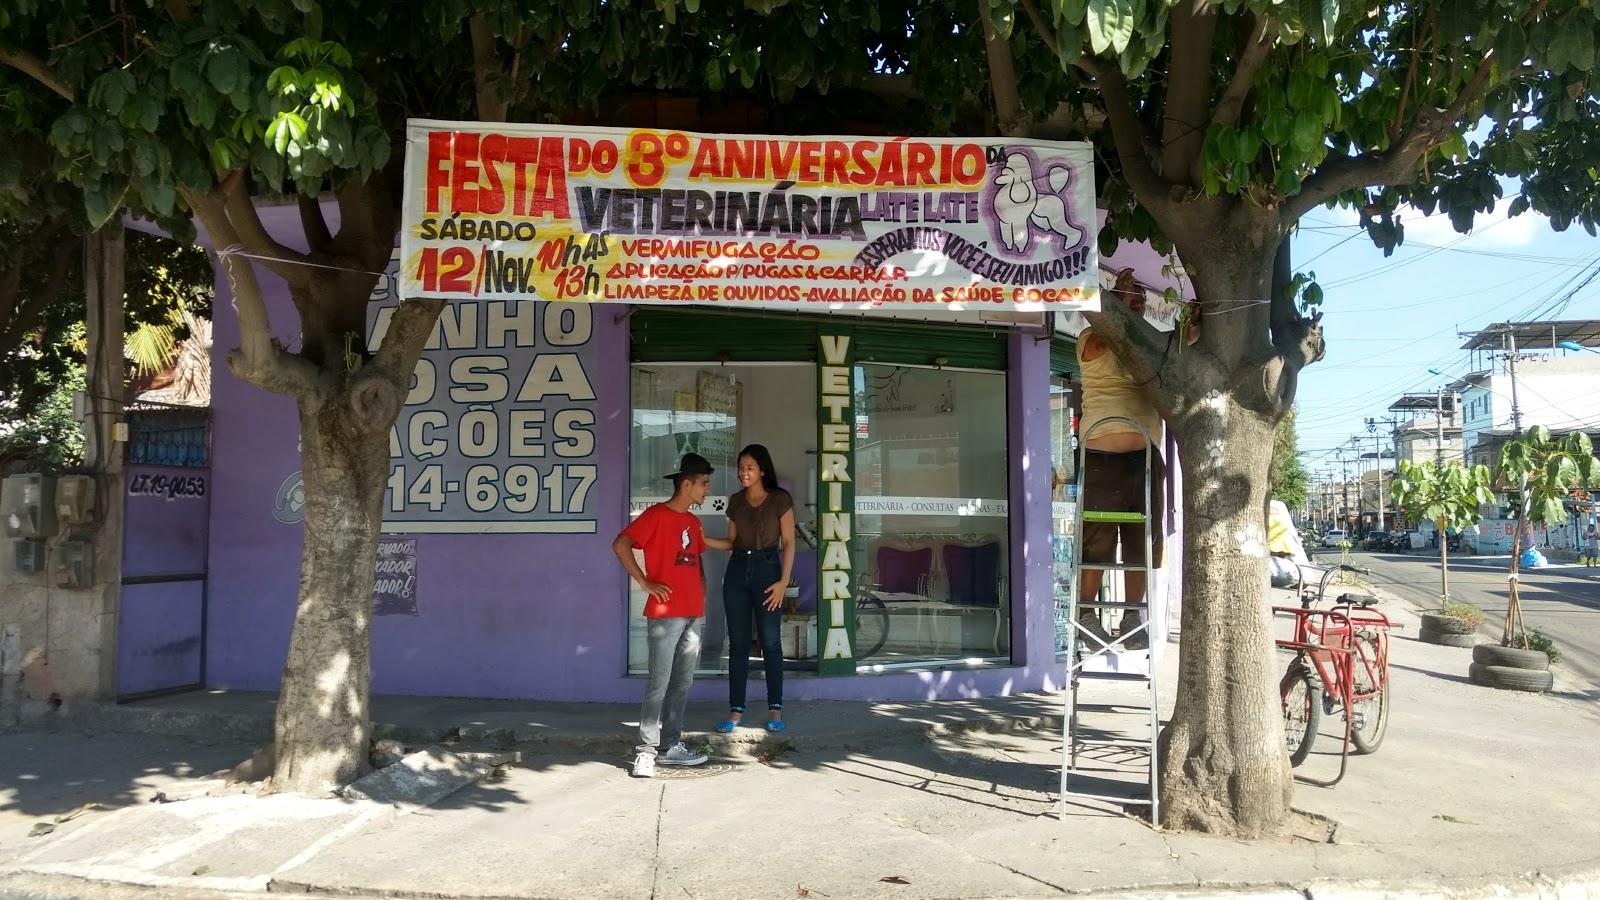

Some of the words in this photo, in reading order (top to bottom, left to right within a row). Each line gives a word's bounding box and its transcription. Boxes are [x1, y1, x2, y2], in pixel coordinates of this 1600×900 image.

[426, 131, 572, 220] FESTA
[568, 138, 618, 174] DO
[689, 136, 987, 187] ANIVERSÁRIO
[985, 145, 1008, 164] DA
[574, 180, 867, 241] VETERINÁRIA
[860, 191, 919, 223] LATE
[923, 191, 979, 223] LATE
[420, 211, 537, 242] SÁBADO
[621, 239, 820, 263] VERMIFUGAÇÃO
[856, 226, 944, 271] ESPERAMOS
[605, 259, 723, 283] APLICAÇÃO
[604, 284, 694, 301] LIMPEZA
[698, 285, 719, 301] DE
[912, 288, 936, 304] DA
[941, 281, 1005, 304] SAÚDE
[911, 501, 954, 512] CONSULTAS
